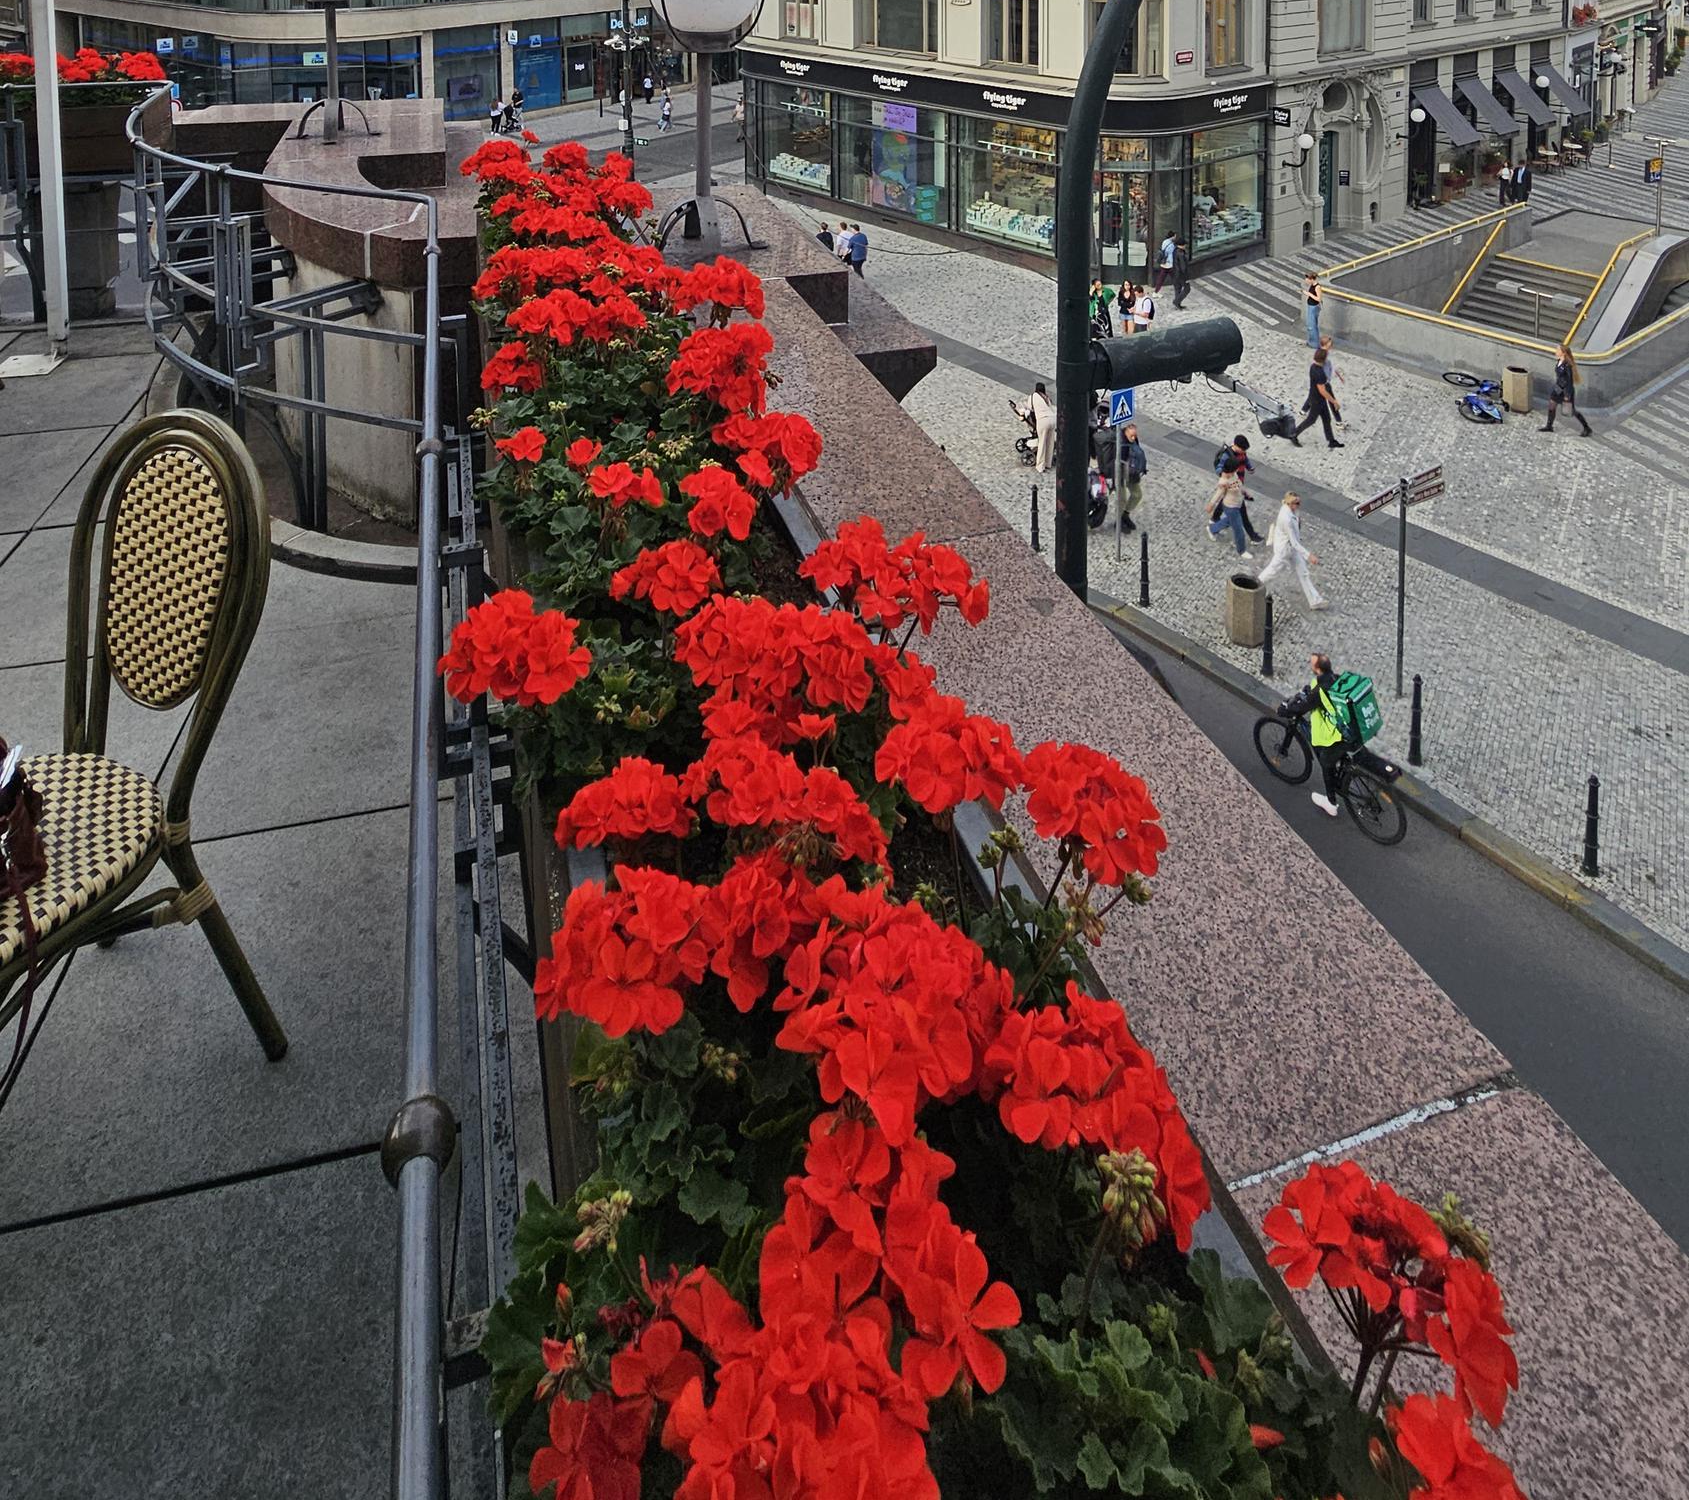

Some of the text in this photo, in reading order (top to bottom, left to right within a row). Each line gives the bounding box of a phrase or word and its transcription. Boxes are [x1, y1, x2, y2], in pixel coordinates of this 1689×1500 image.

[780, 60, 810, 72] flying tiger
[872, 74, 909, 88] flying tiger
[983, 91, 1027, 106] flying tiger
[1213, 94, 1248, 108] flying tiger
